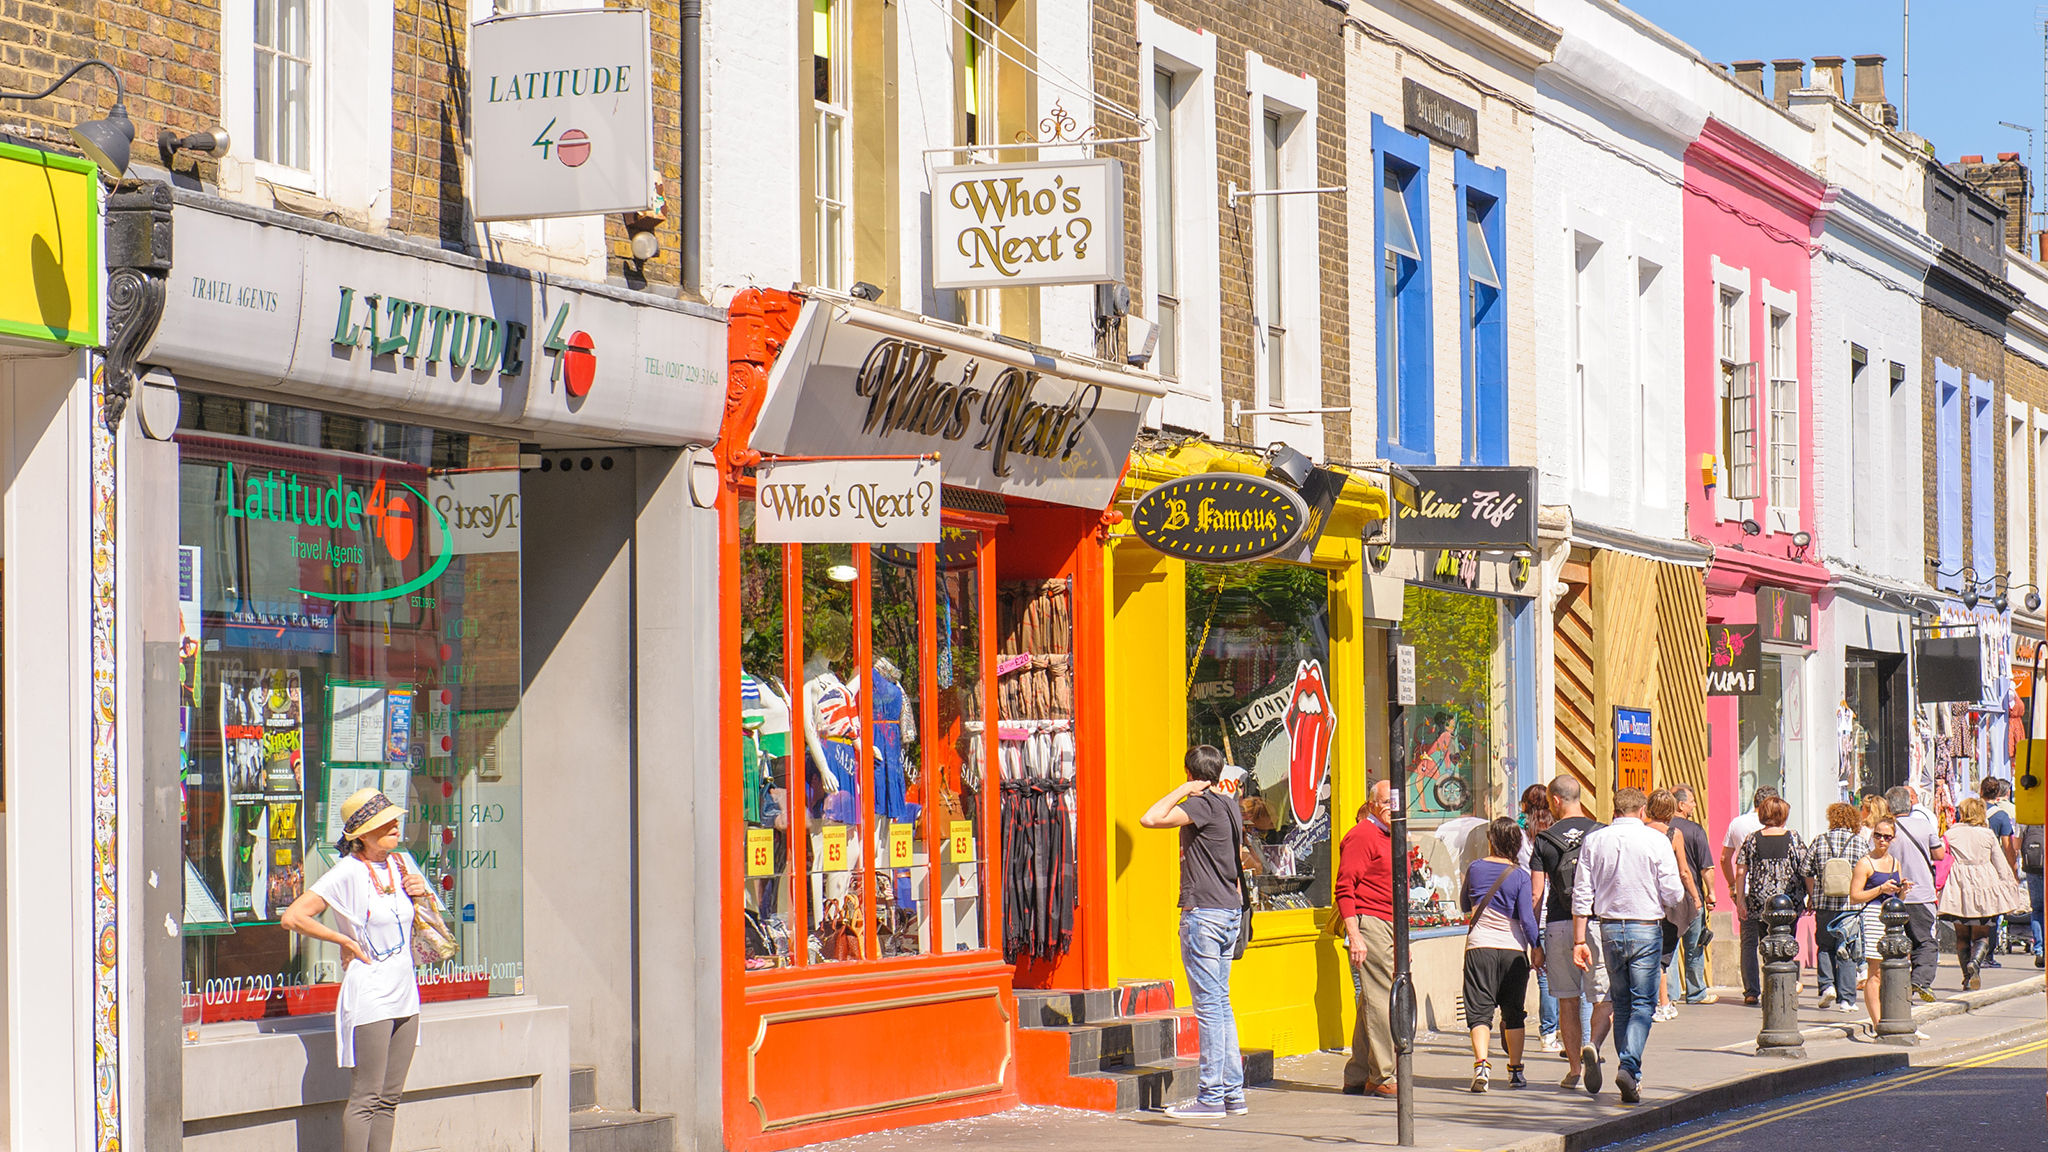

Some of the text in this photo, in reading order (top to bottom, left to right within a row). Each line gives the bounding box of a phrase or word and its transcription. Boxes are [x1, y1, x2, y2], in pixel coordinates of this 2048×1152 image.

[487, 64, 632, 103] LATITUDE
[949, 174, 1081, 224] Who's
[957, 217, 1093, 277] Next?
[191, 276, 279, 313] TRAVEL AGENTS
[331, 283, 528, 378] LATITUDE
[645, 357, 719, 386] TEL: 0207 229 3164
[856, 336, 1104, 479] Who's Next?
[226, 461, 363, 531] Latitude
[761, 480, 934, 528] Who's Next?
[1471, 490, 1523, 528] Fifi
[1161, 497, 1191, 532] B
[1195, 497, 1279, 532] Famous
[289, 536, 363, 568] Travel Agents
[1014, 654, 1029, 667] £20
[225, 724, 263, 739] CHICAGO
[834, 743, 856, 776] SALE
[899, 748, 918, 785] SALE
[1621, 748, 1649, 763] RESTAURANT
[961, 763, 979, 793] SALE
[1625, 768, 1648, 792] TO LET
[755, 847, 767, 866] £5
[829, 844, 841, 861] £5
[896, 840, 907, 858] £5
[956, 837, 967, 854] £5
[205, 977, 242, 1005] 0207
[246, 974, 273, 1002] 229
[276, 971, 310, 999] 3164
